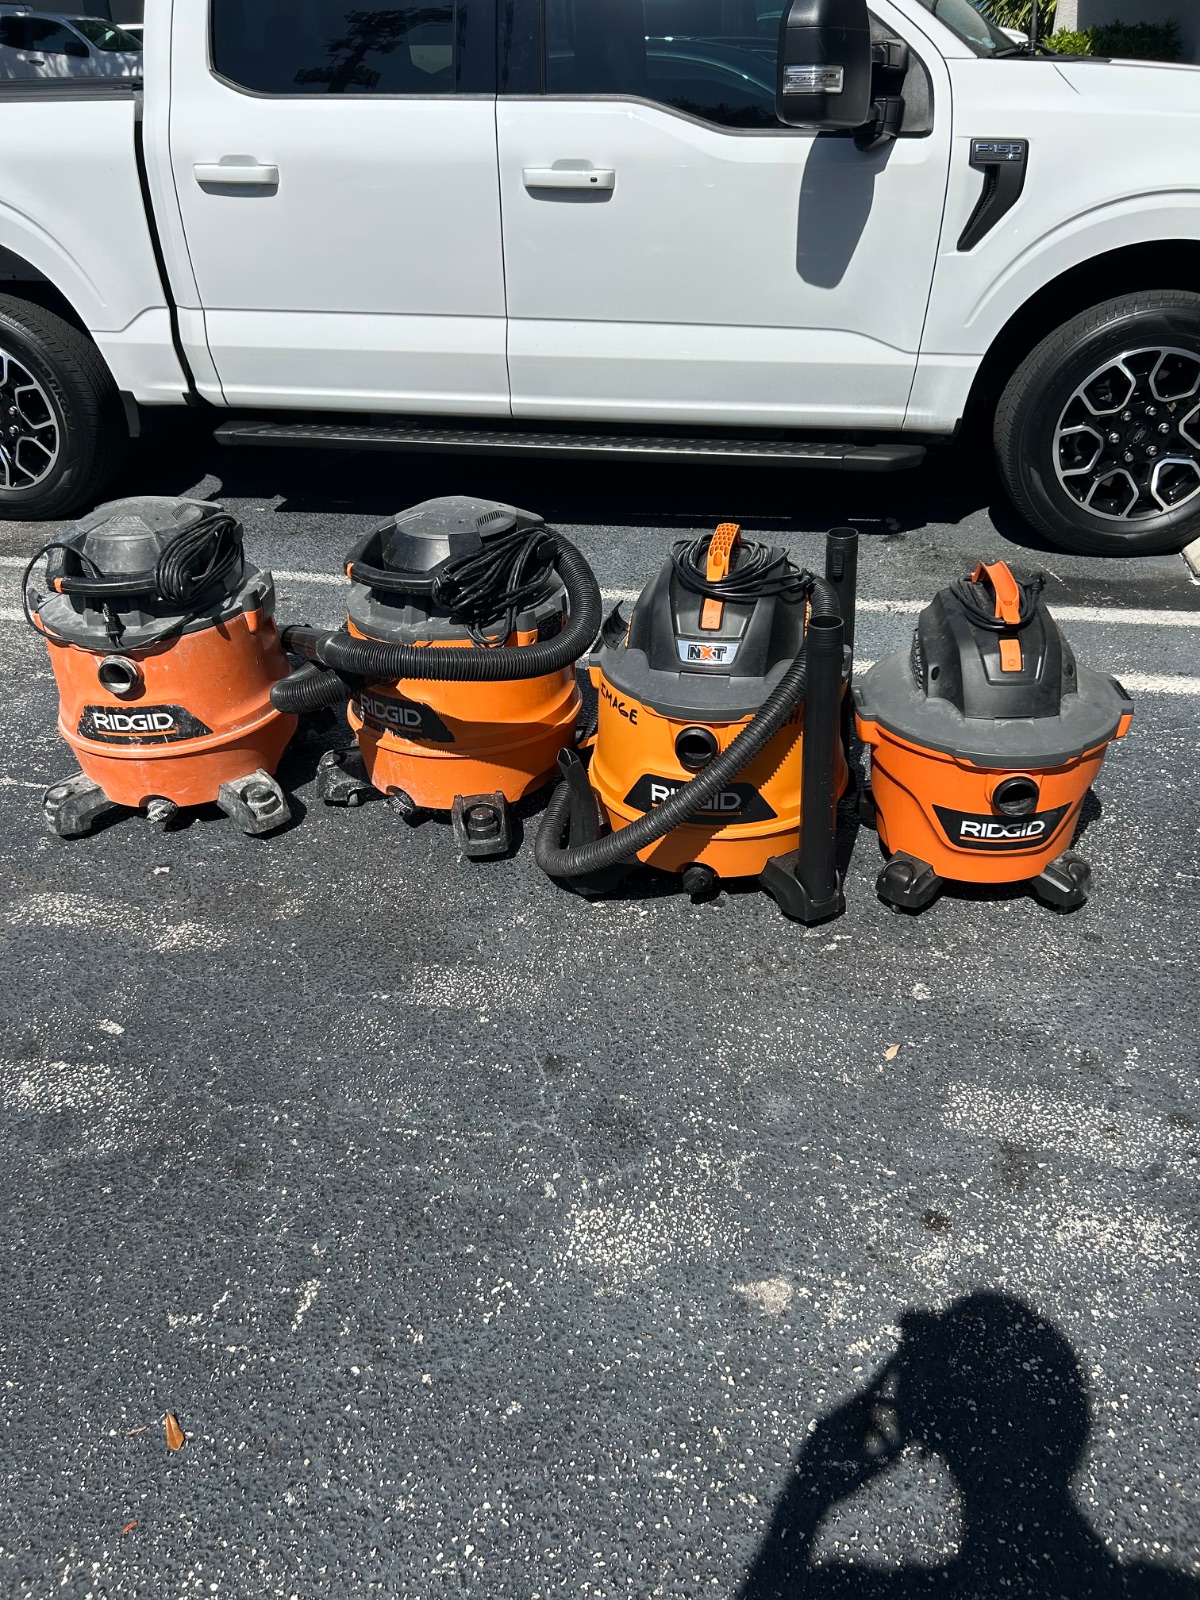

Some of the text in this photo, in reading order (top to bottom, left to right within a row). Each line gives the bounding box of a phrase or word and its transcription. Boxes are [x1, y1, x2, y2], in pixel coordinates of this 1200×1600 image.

[687, 644, 727, 661] NXT
[360, 693, 422, 726] RIDGID
[601, 682, 638, 725] IMAGE
[92, 712, 173, 731] RIDGID
[960, 820, 1046, 838] RIDGID
